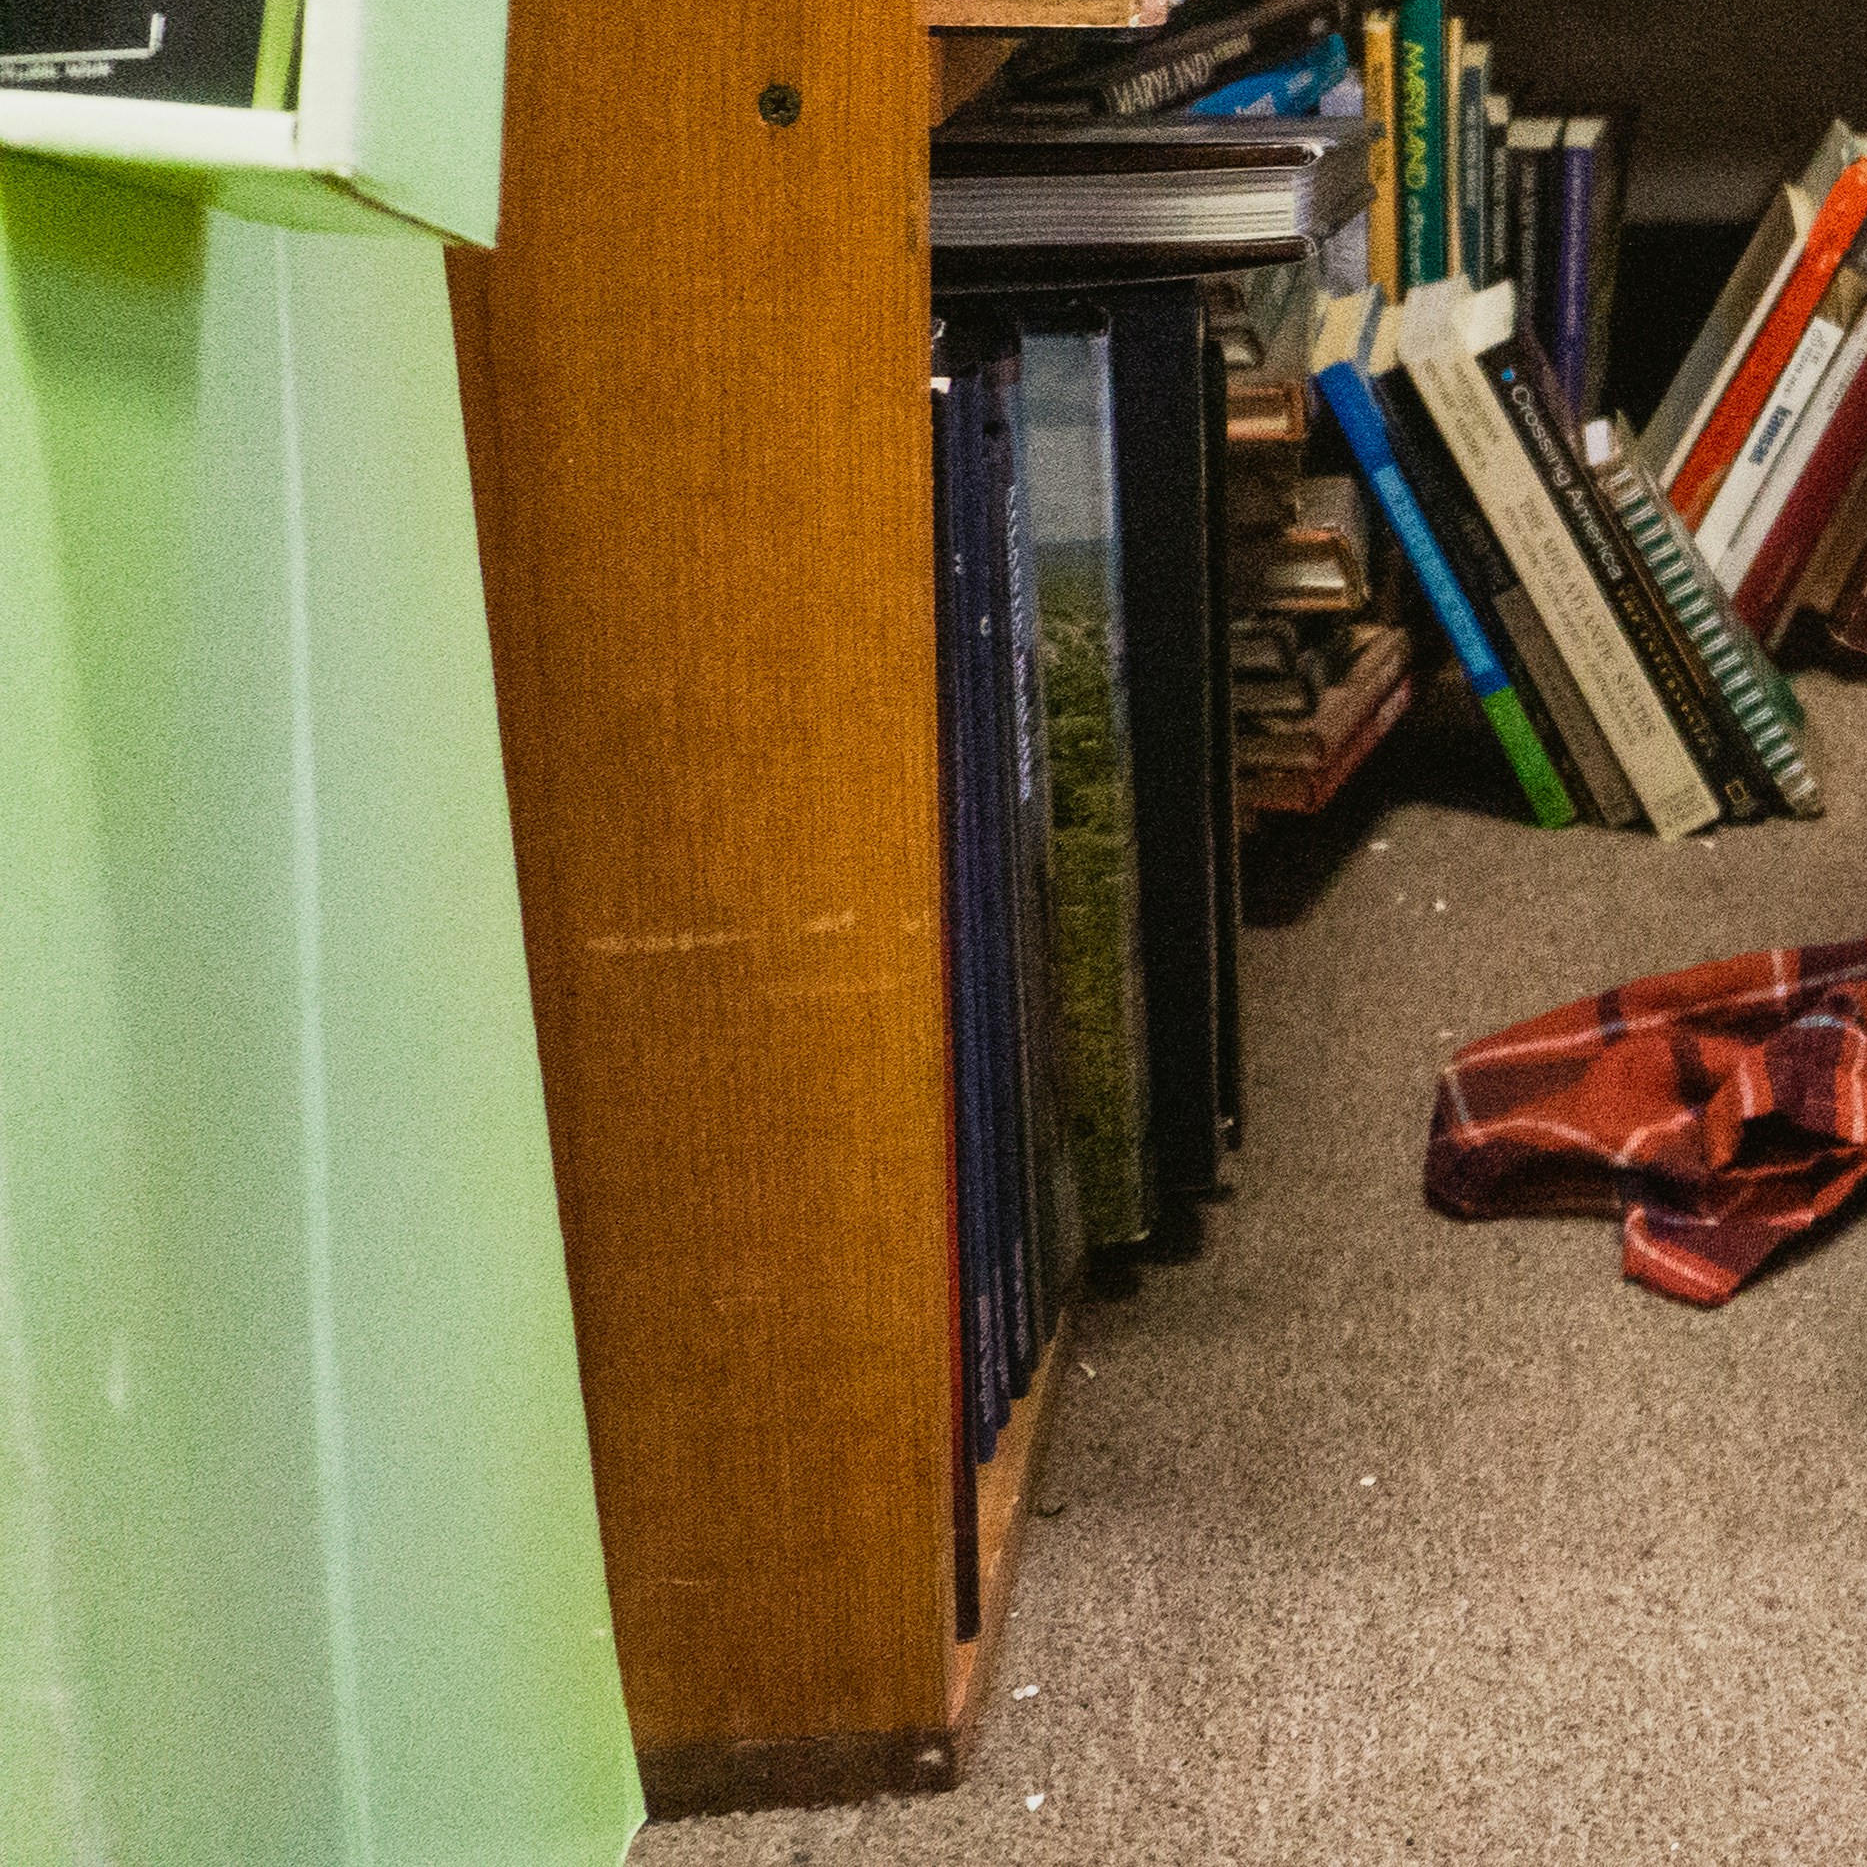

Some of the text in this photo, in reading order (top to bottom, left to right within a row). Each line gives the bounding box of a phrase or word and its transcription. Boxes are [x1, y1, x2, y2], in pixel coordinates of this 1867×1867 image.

[1108, 50, 1215, 117] MARYLAND
[1400, 40, 1428, 189] MARYLAND
[1745, 401, 1794, 471] kansas
[1501, 381, 1631, 583] Crossing America
[1514, 494, 1549, 536] THE
